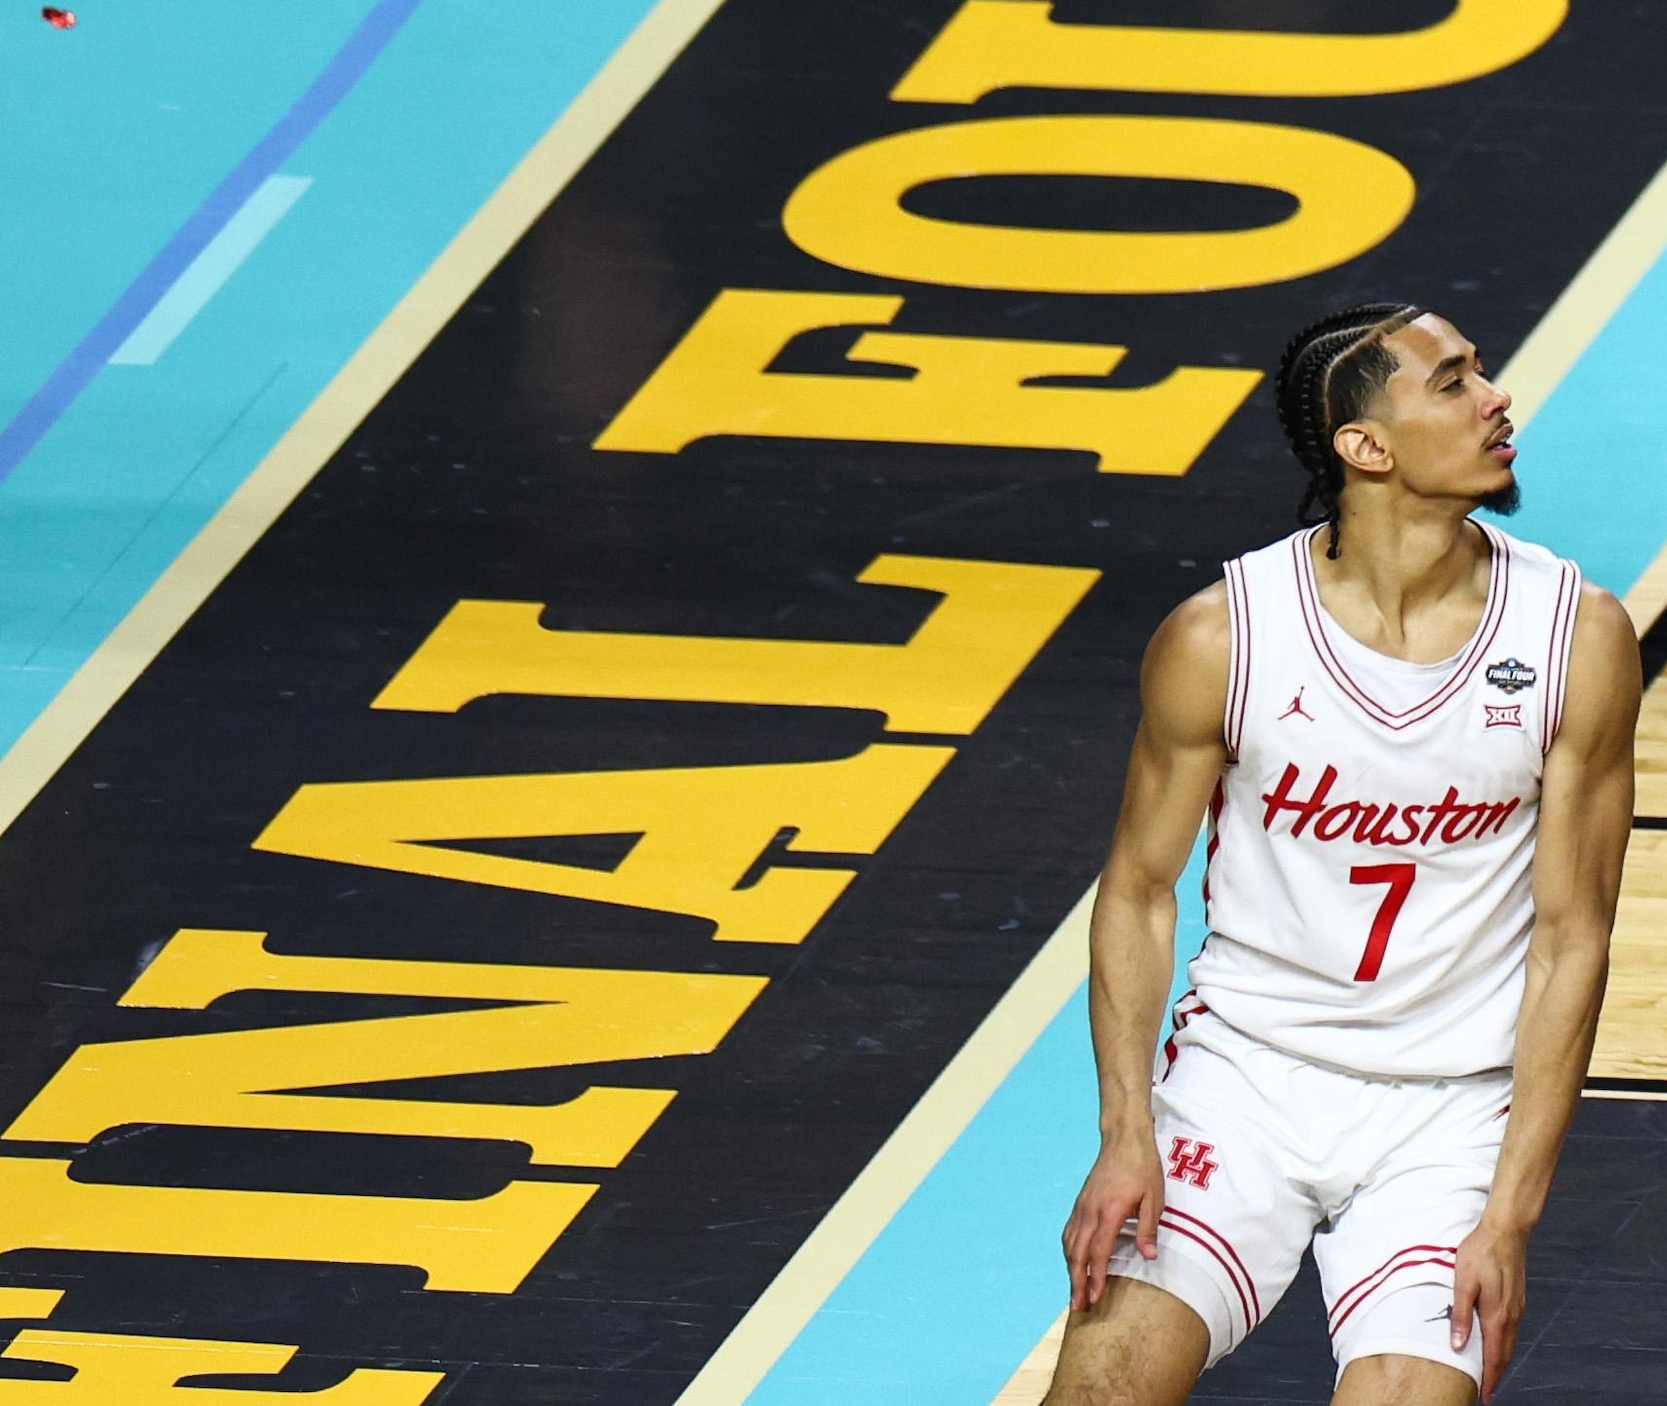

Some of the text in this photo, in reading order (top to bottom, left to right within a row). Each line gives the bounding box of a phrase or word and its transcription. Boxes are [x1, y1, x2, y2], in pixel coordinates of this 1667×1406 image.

[1488, 668, 1536, 682] FINAL FOUR
[1262, 760, 1521, 846] Houston
[1349, 862, 1417, 982] 7
